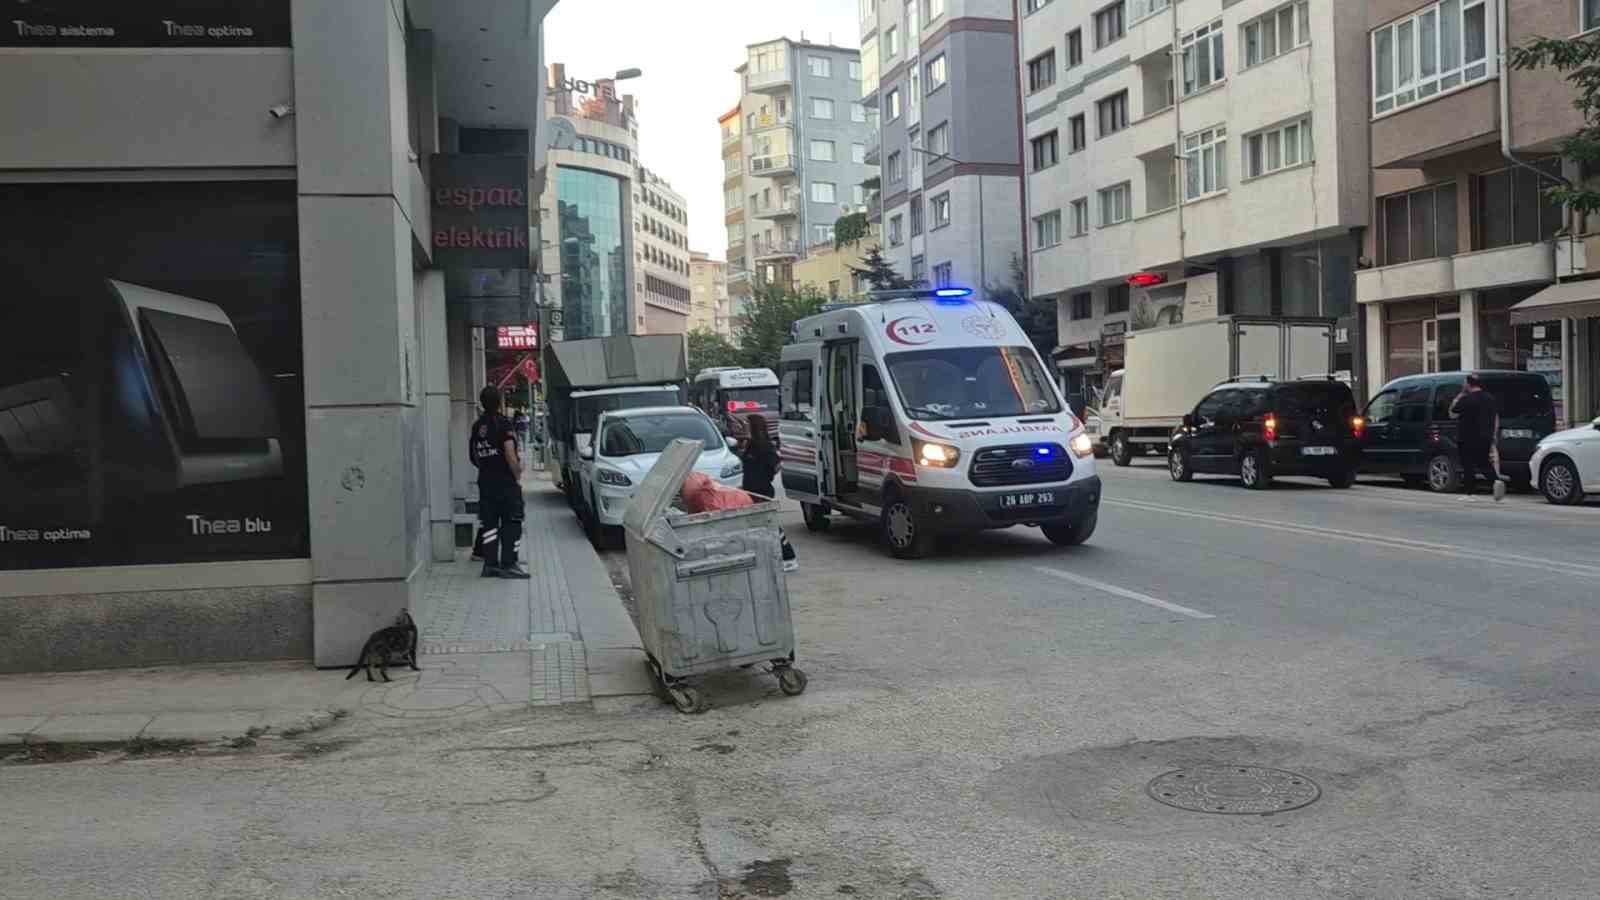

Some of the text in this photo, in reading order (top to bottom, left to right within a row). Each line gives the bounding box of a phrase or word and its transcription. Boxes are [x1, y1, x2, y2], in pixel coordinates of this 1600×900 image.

[13, 20, 56, 36] Thea
[162, 20, 253, 38] Thea optima
[434, 224, 527, 248] elektrik
[898, 324, 936, 335] 112
[186, 515, 271, 535] Thea blu
[43, 528, 91, 542] optima
